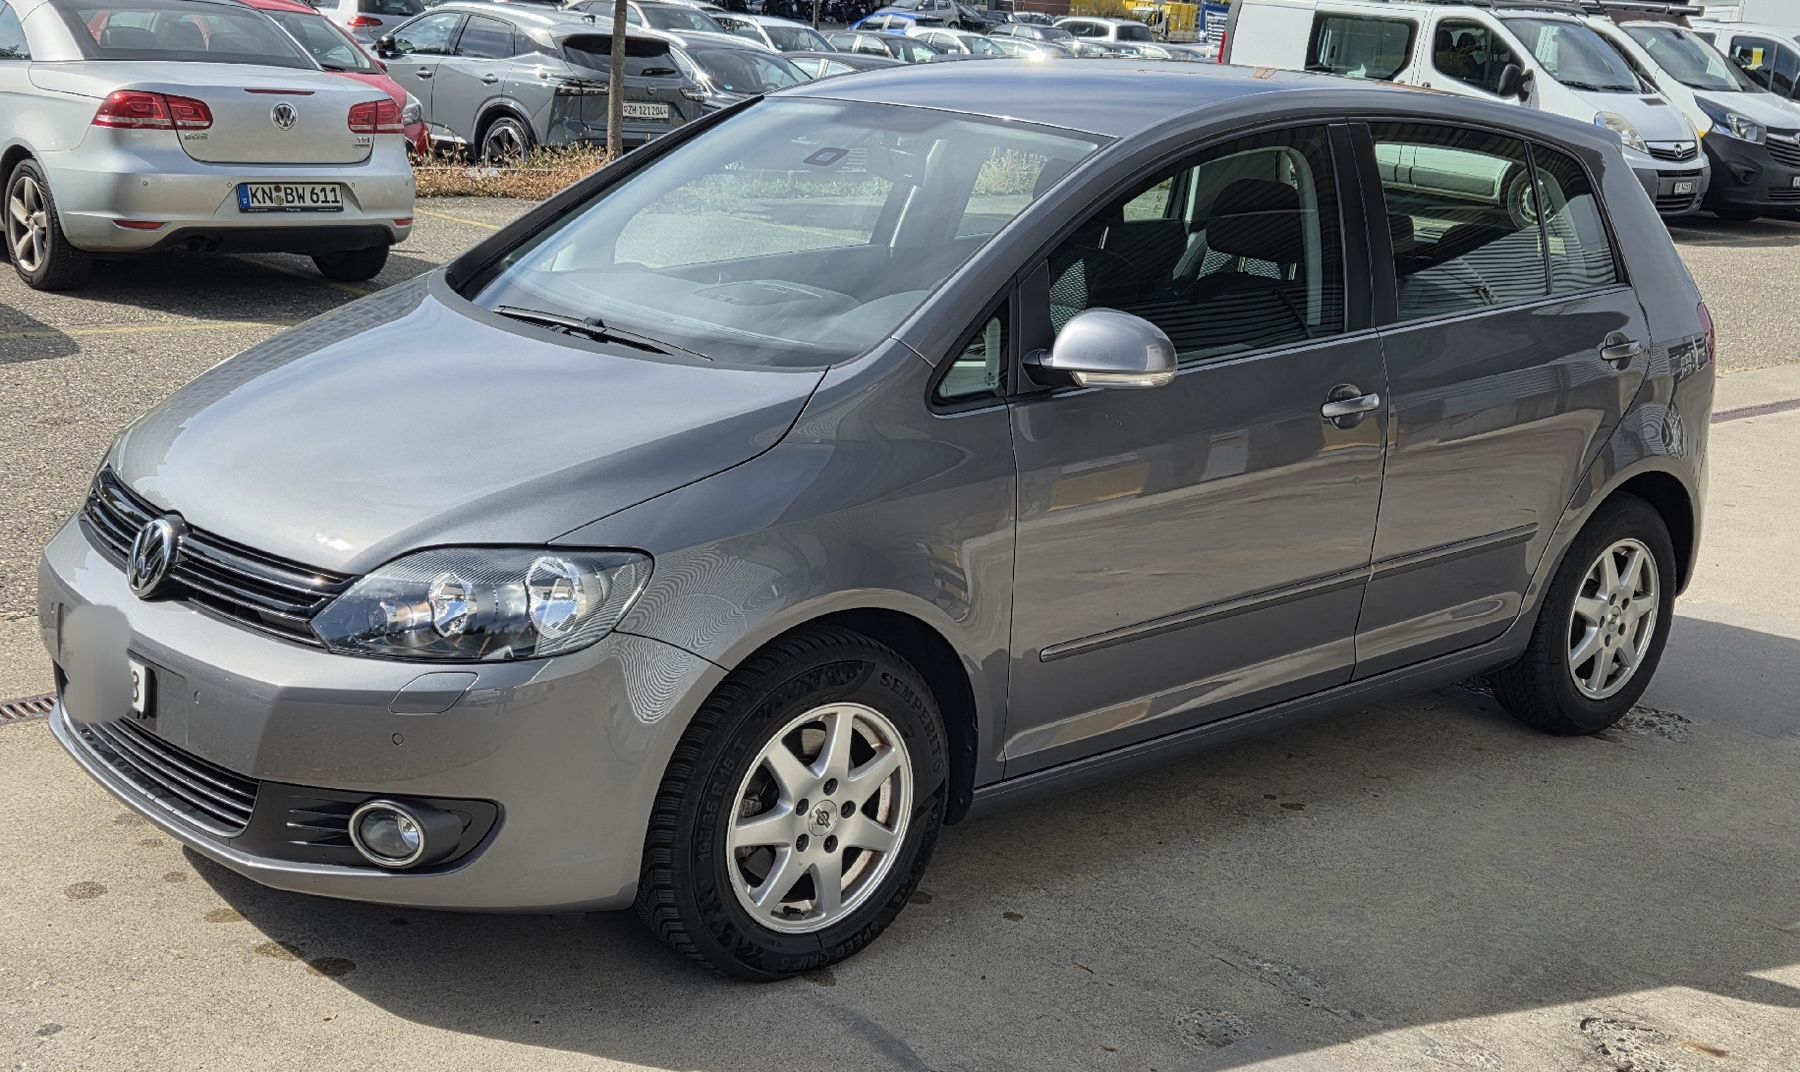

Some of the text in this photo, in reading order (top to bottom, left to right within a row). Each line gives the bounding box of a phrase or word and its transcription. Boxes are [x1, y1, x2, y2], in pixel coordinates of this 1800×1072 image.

[249, 186, 340, 204] KN BW 611
[879, 672, 942, 757] SEMPERIT
